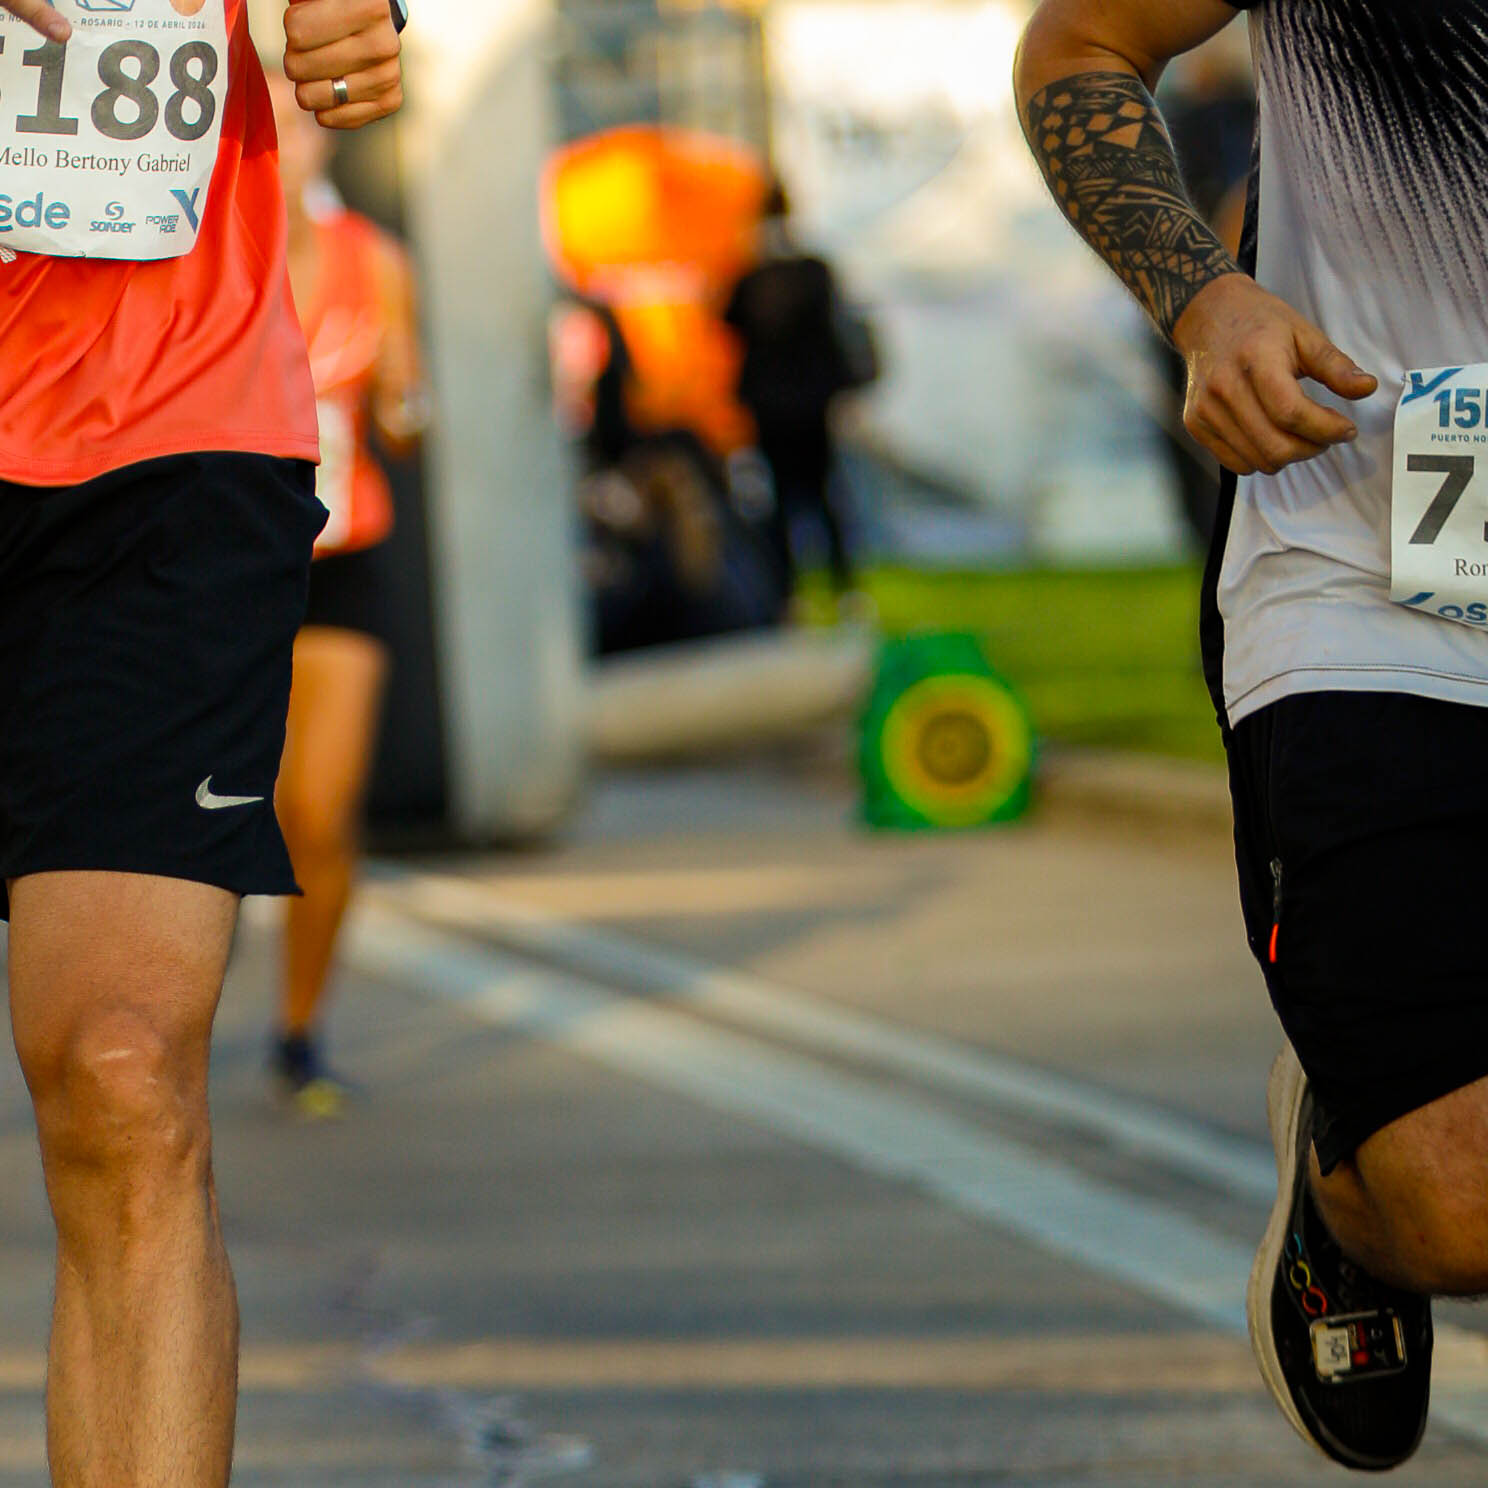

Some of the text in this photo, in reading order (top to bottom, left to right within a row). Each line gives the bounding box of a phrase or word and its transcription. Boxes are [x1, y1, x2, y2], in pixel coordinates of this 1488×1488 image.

[80, 17, 124, 28] ROSARIO
[147, 19, 159, 29] DE
[161, 19, 186, 30] ABRIL
[55, 149, 131, 176] Bertony
[137, 152, 191, 173] Gabriel
[144, 215, 180, 225] POWER
[1433, 387, 1488, 429] 15
[1431, 432, 1470, 442] PUERTO
[1407, 453, 1488, 545] 7
